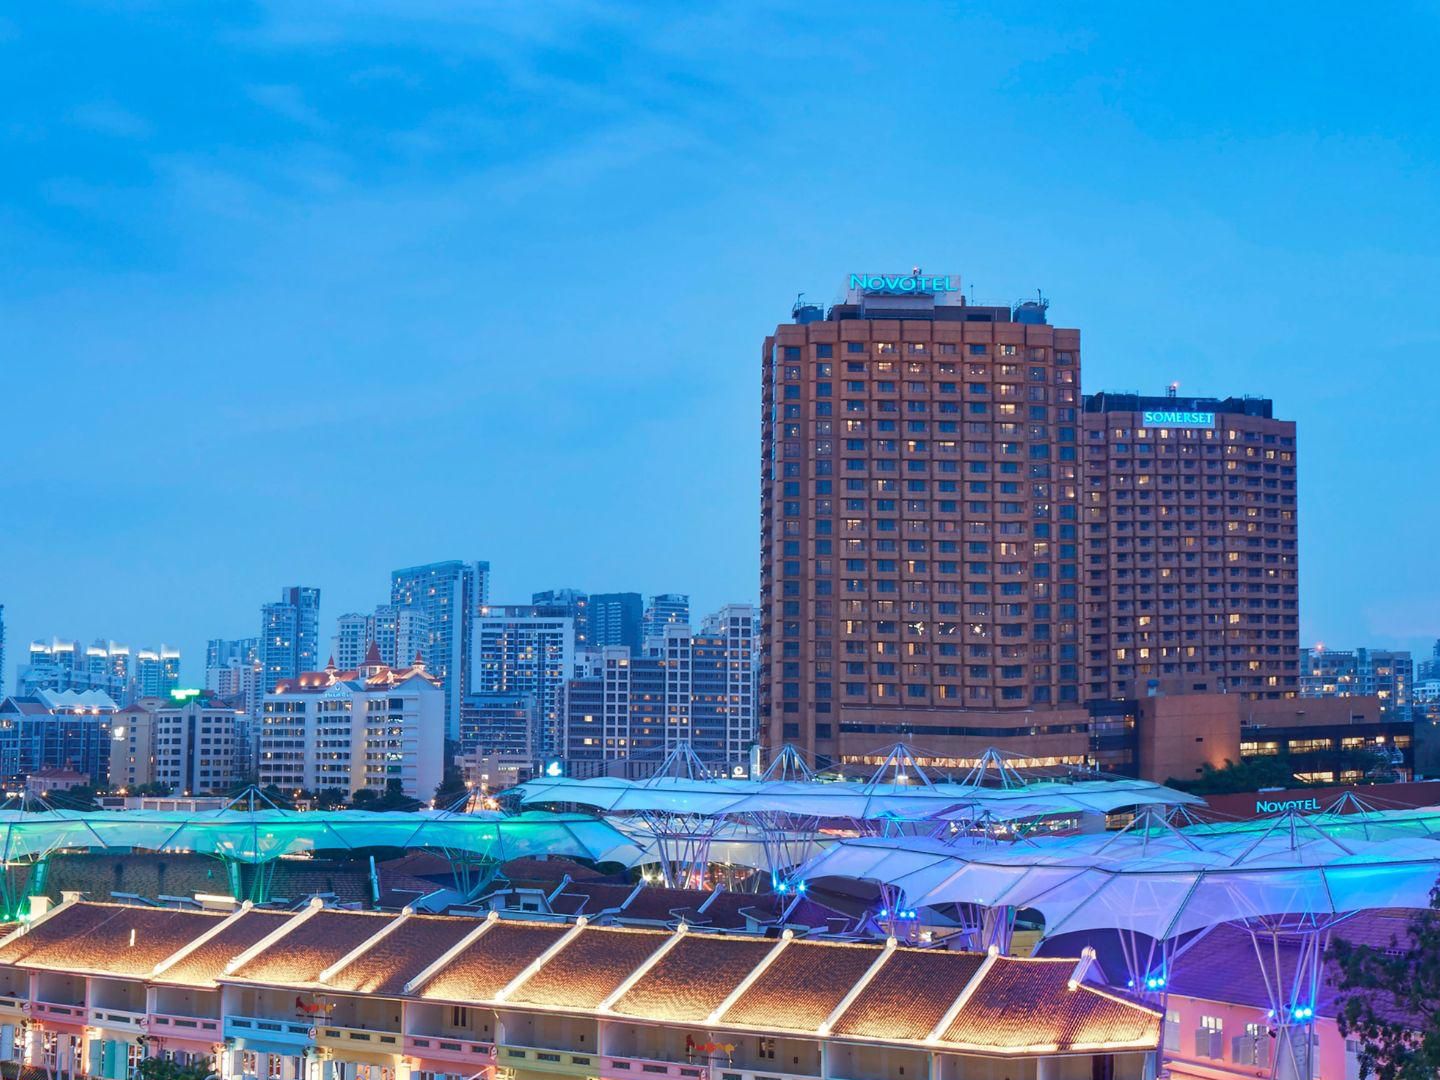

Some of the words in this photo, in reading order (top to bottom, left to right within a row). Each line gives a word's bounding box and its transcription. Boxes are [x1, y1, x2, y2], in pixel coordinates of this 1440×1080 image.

[850, 274, 958, 292] NOVOTEL
[1145, 411, 1213, 424] SOMERSET
[1256, 797, 1321, 813] NOVOTEL
